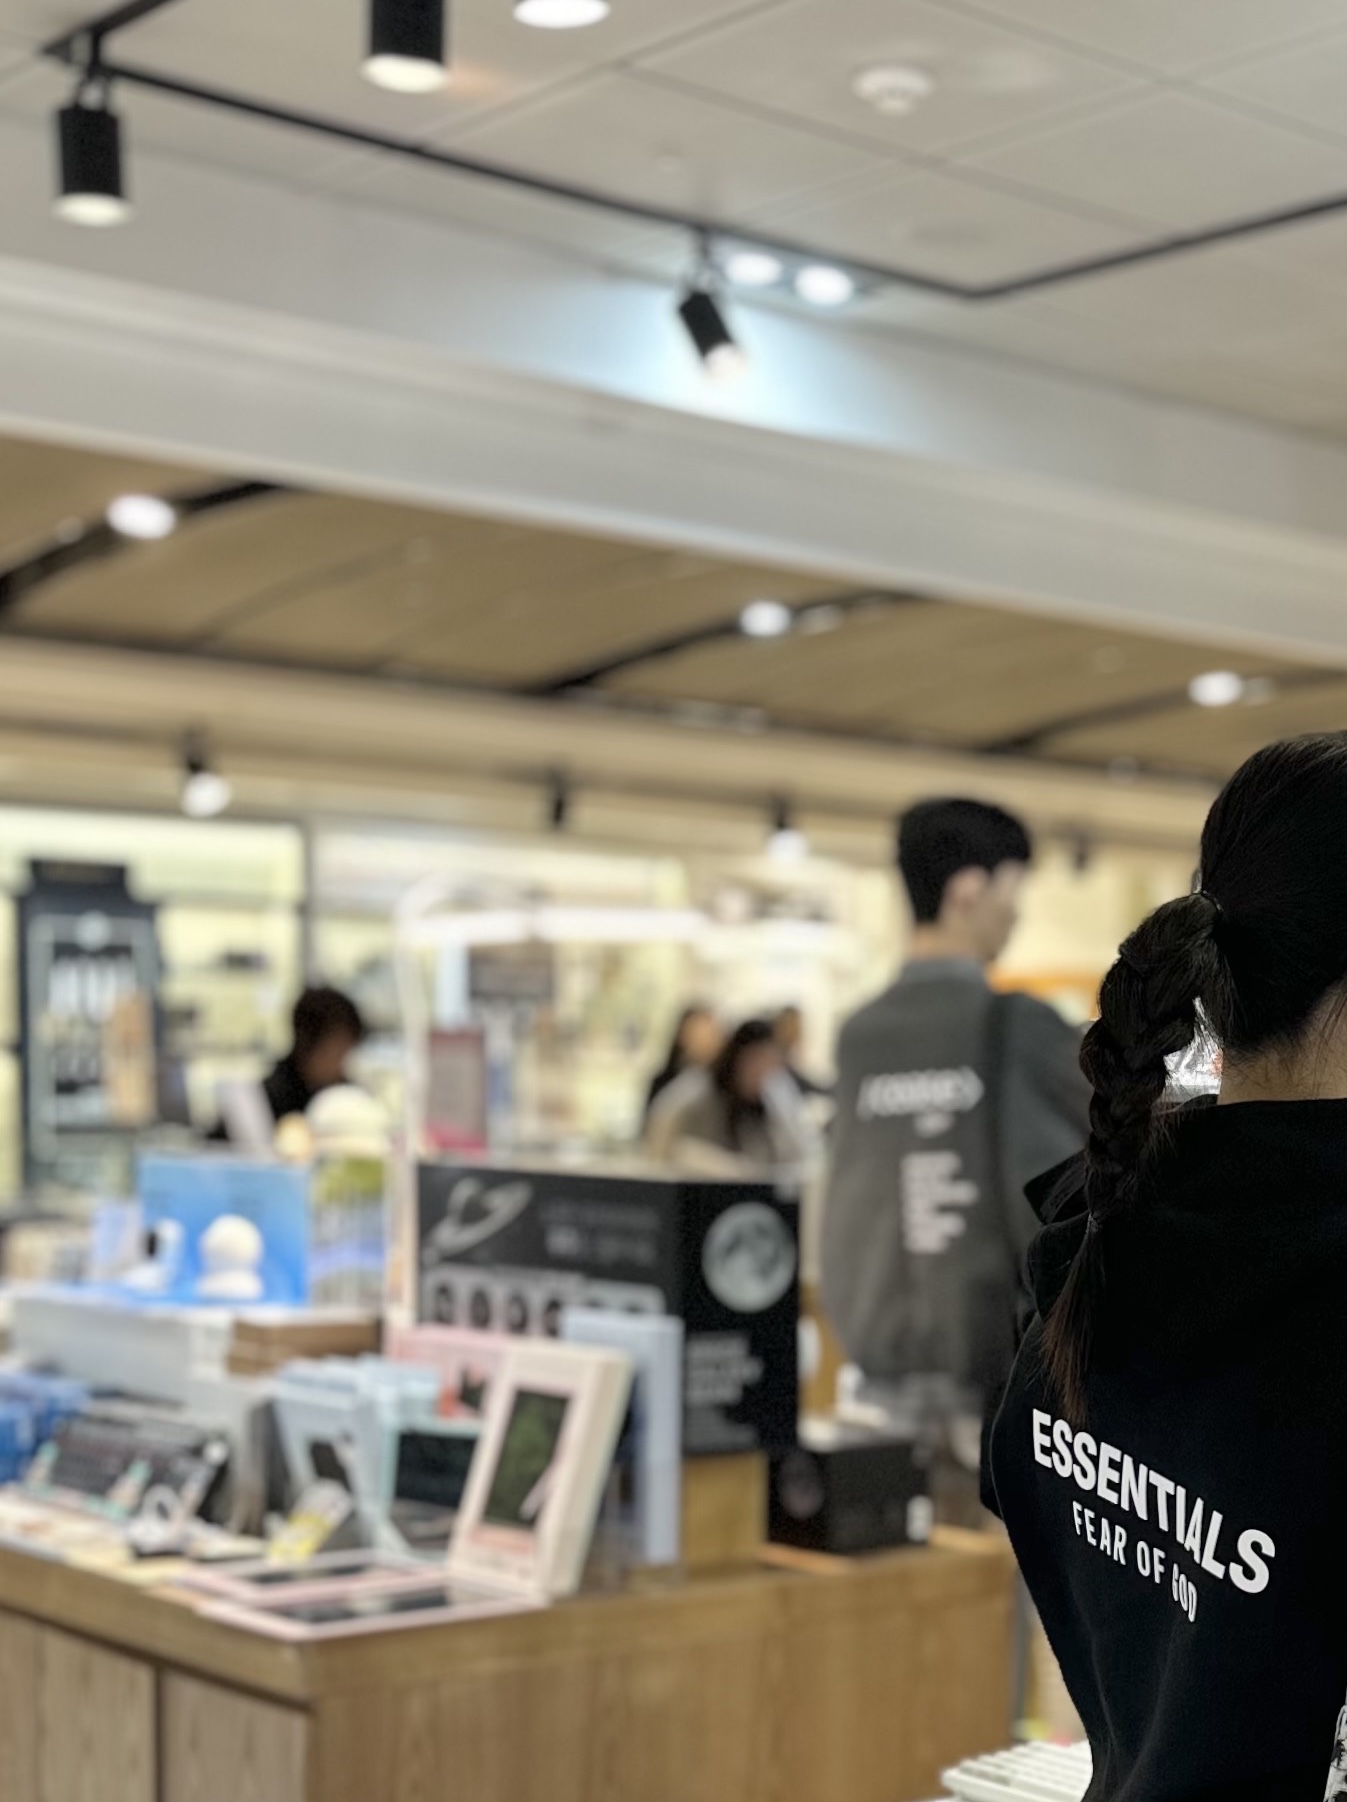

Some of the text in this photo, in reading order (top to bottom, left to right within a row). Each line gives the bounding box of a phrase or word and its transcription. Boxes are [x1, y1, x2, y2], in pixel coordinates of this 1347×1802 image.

[1032, 1408, 1276, 1594] ESSENTIALS
[1072, 1500, 1198, 1623] FEAR OF GOD
